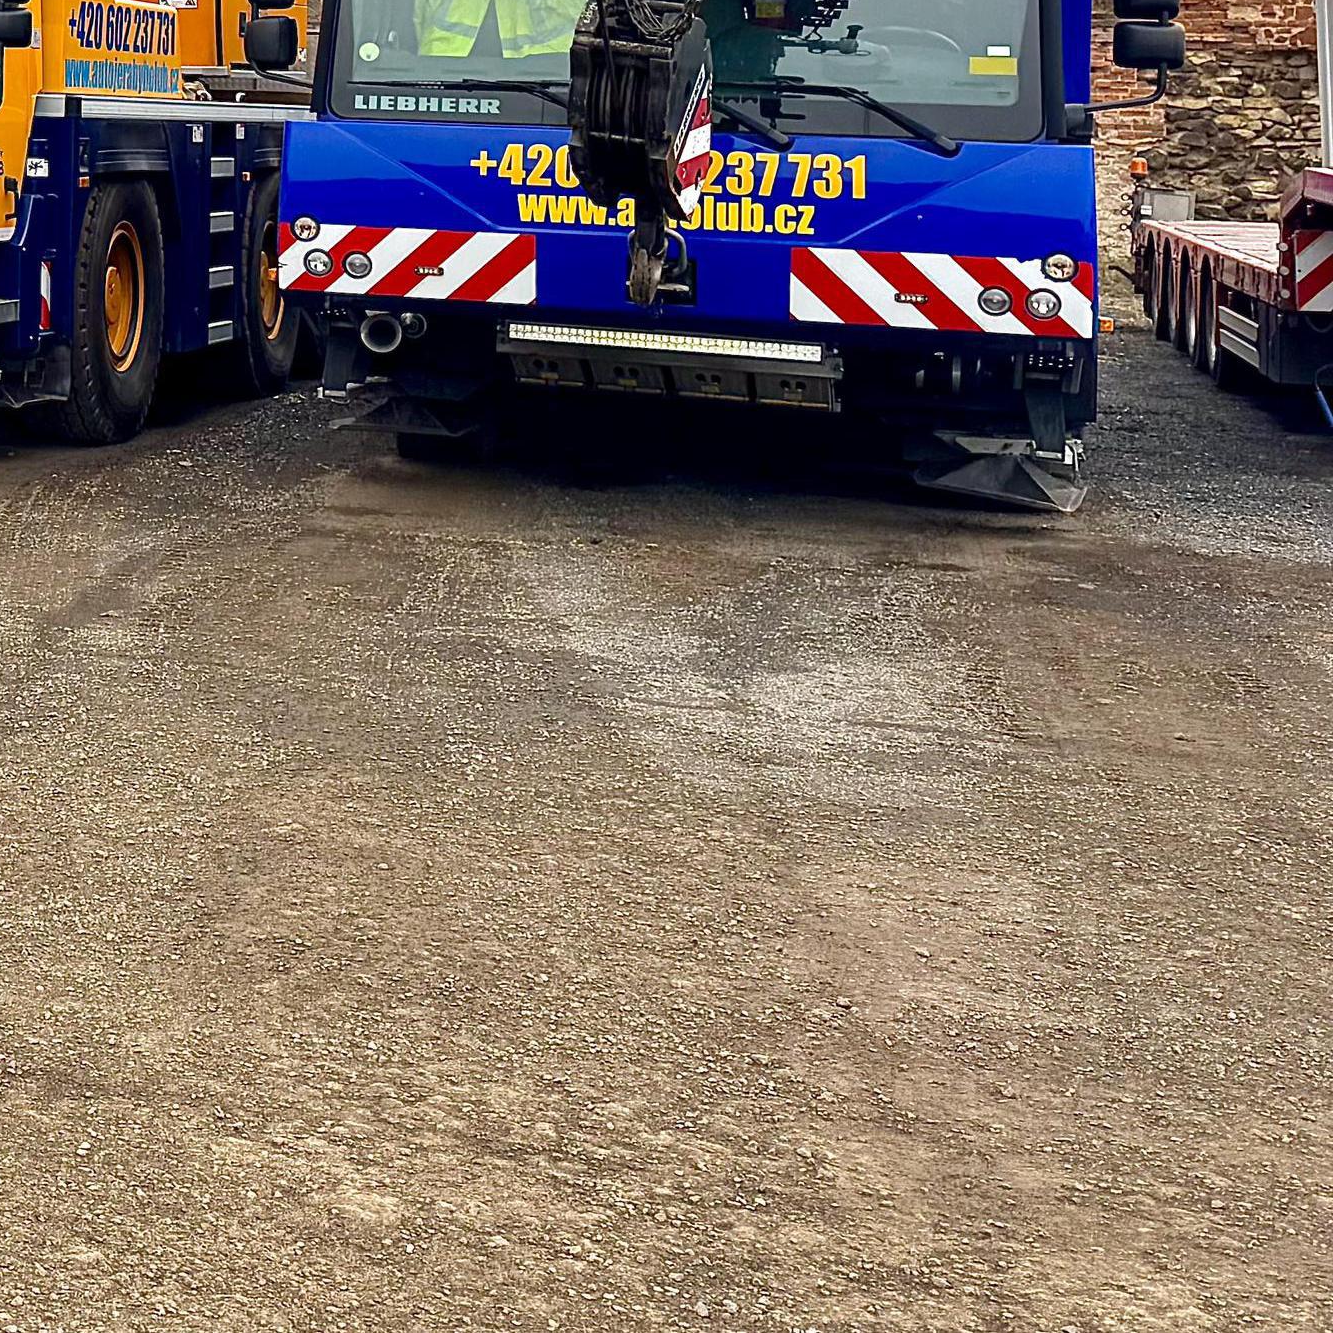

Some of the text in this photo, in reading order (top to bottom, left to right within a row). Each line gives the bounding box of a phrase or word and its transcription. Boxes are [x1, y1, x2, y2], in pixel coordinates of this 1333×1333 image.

[68, 0, 176, 56] +420 602 237 731
[354, 94, 501, 114] LIEBHERR
[470, 143, 867, 199] +420 237 731
